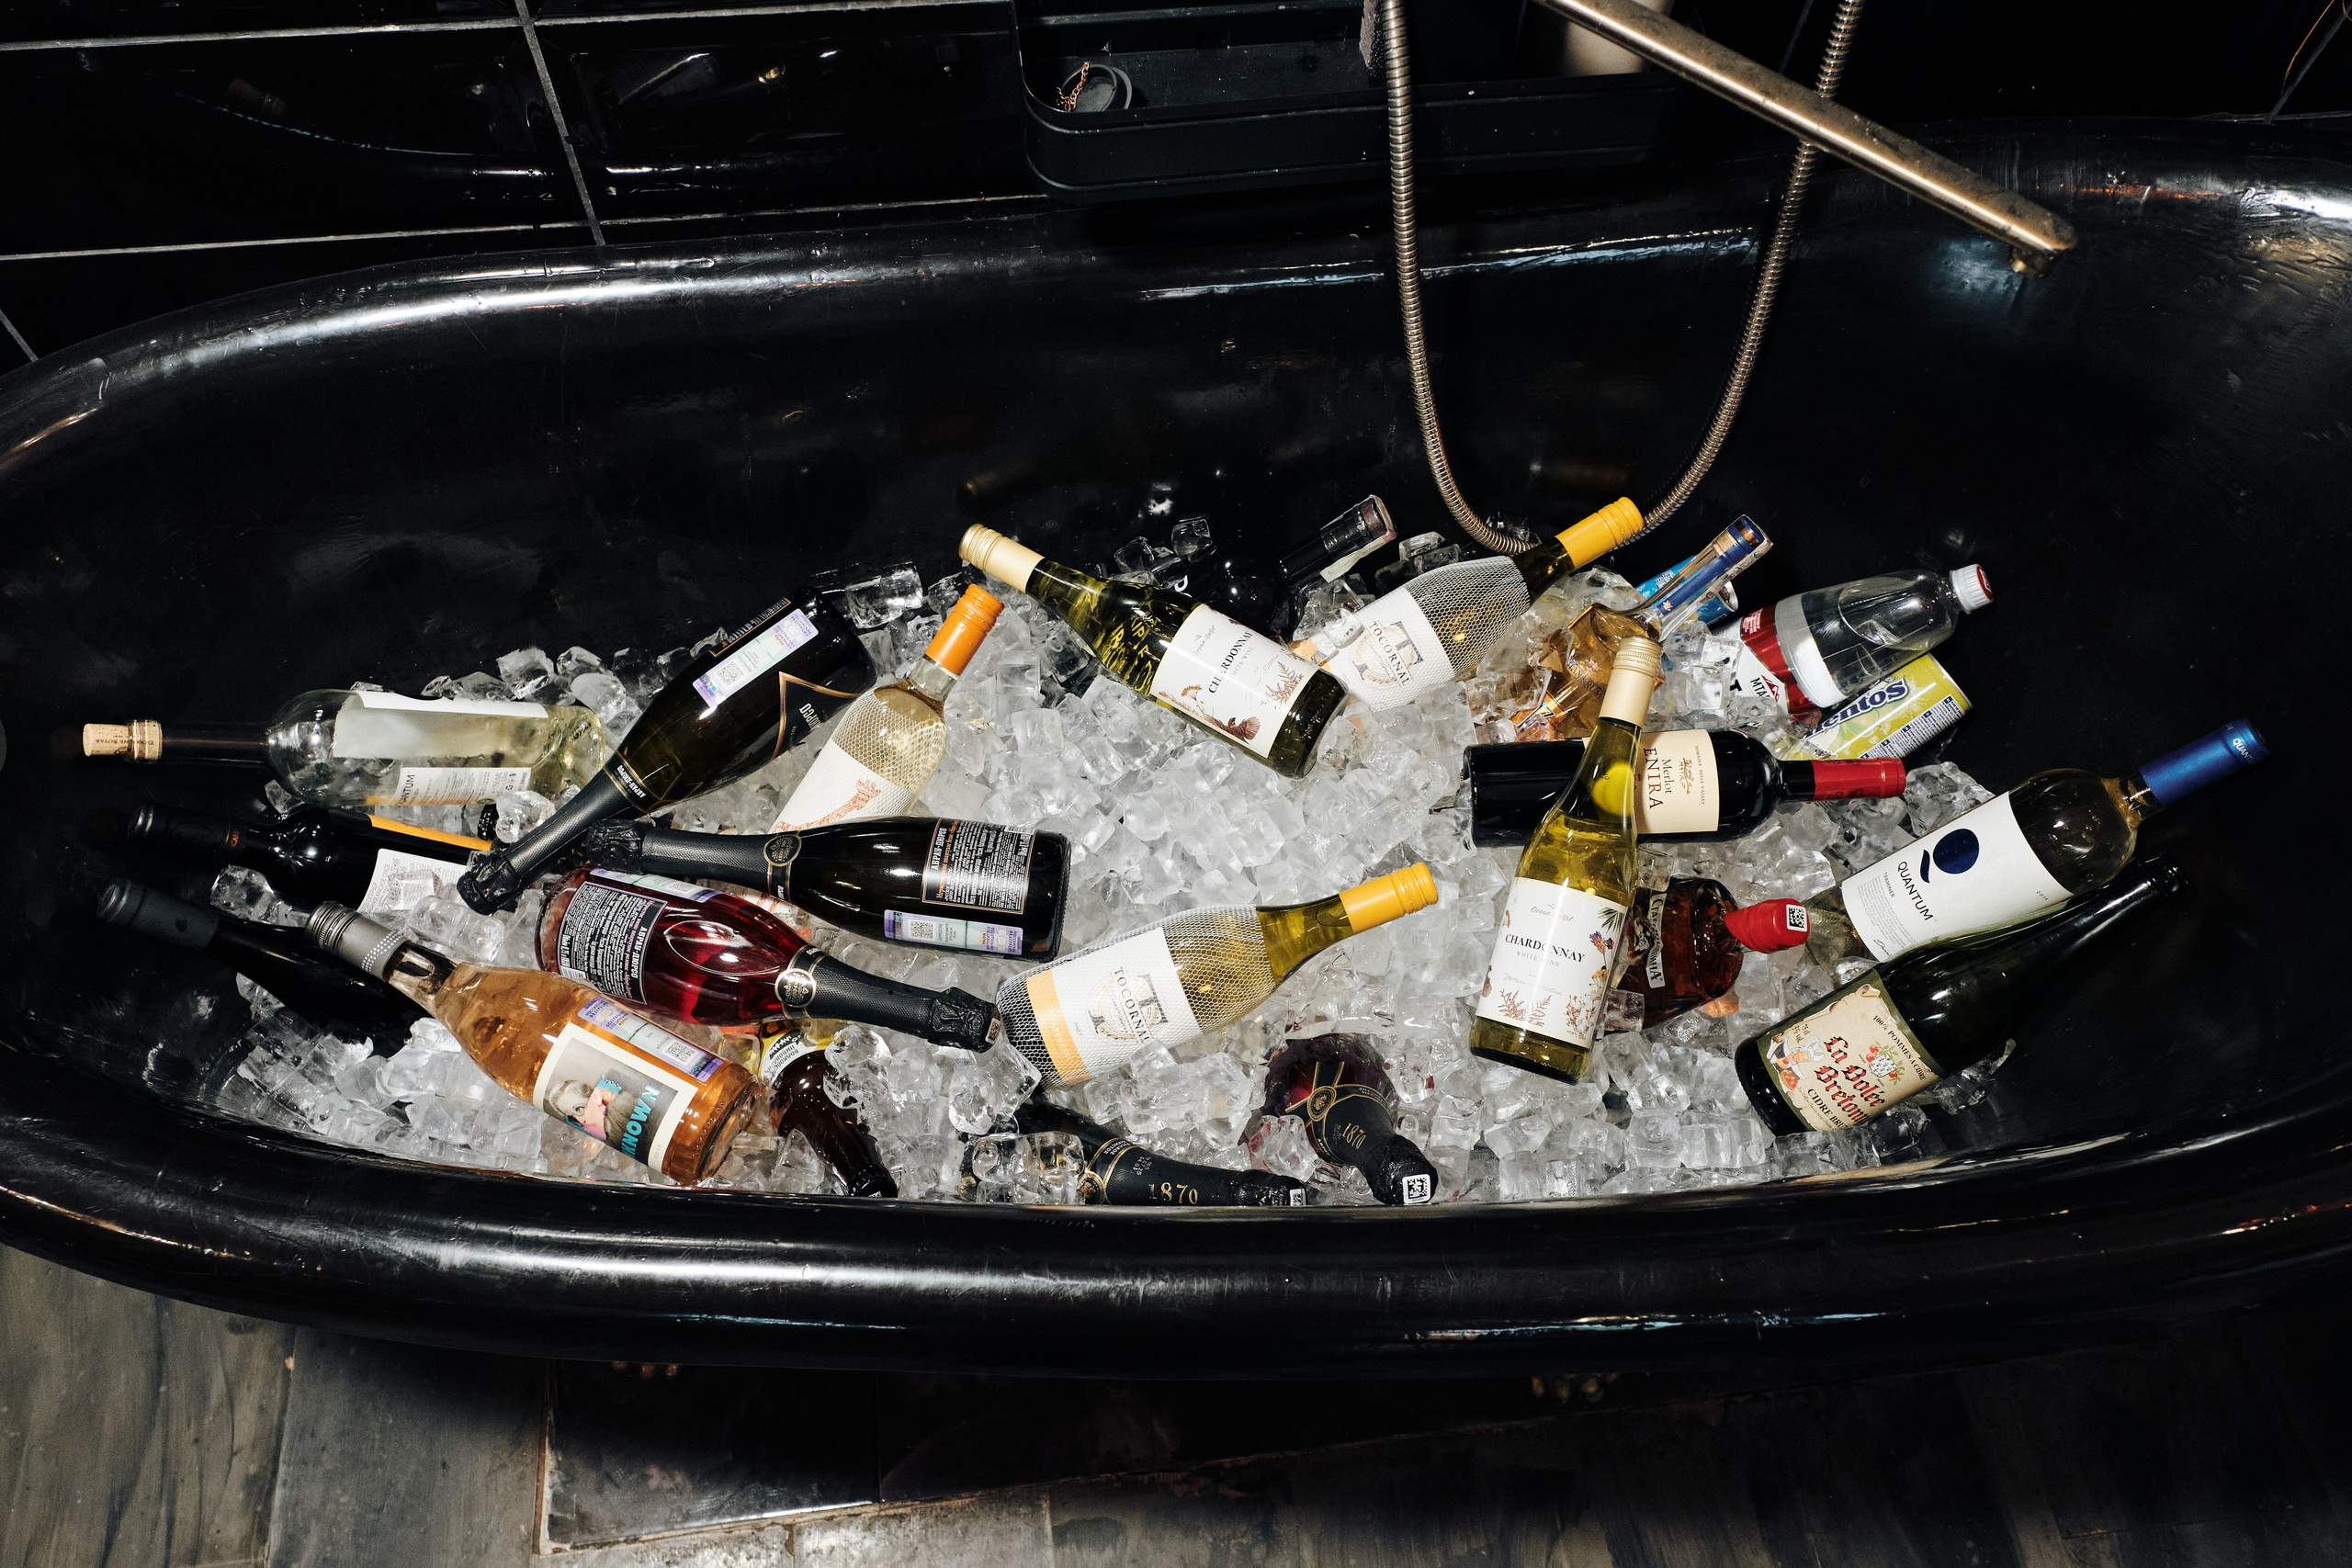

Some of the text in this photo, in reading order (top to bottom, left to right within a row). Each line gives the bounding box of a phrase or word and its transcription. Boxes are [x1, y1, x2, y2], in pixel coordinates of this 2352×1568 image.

[1206, 629, 1253, 694] CHRDONNAY
[1368, 620, 1409, 686] TOCORNAL
[1643, 747, 1663, 809] ENIRA
[1661, 758, 1674, 794] Merlot
[1882, 871, 1894, 898] TRAMINER
[1896, 860, 1934, 921] QUANTUM
[1539, 957, 1560, 967] INE
[1113, 965, 1150, 1044] TOCORNAL
[1822, 1034, 1887, 1109] La Bolée
[1872, 1014, 1889, 1032] 100%
[1886, 1029, 1914, 1060] POMMES
[1912, 1062, 1927, 1081] CIDRE
[620, 1083, 662, 1158] KNOWN
[1807, 1088, 1833, 1116] CIDRE
[1341, 1122, 1367, 1150] 1870
[1147, 1179, 1199, 1205] 1870
